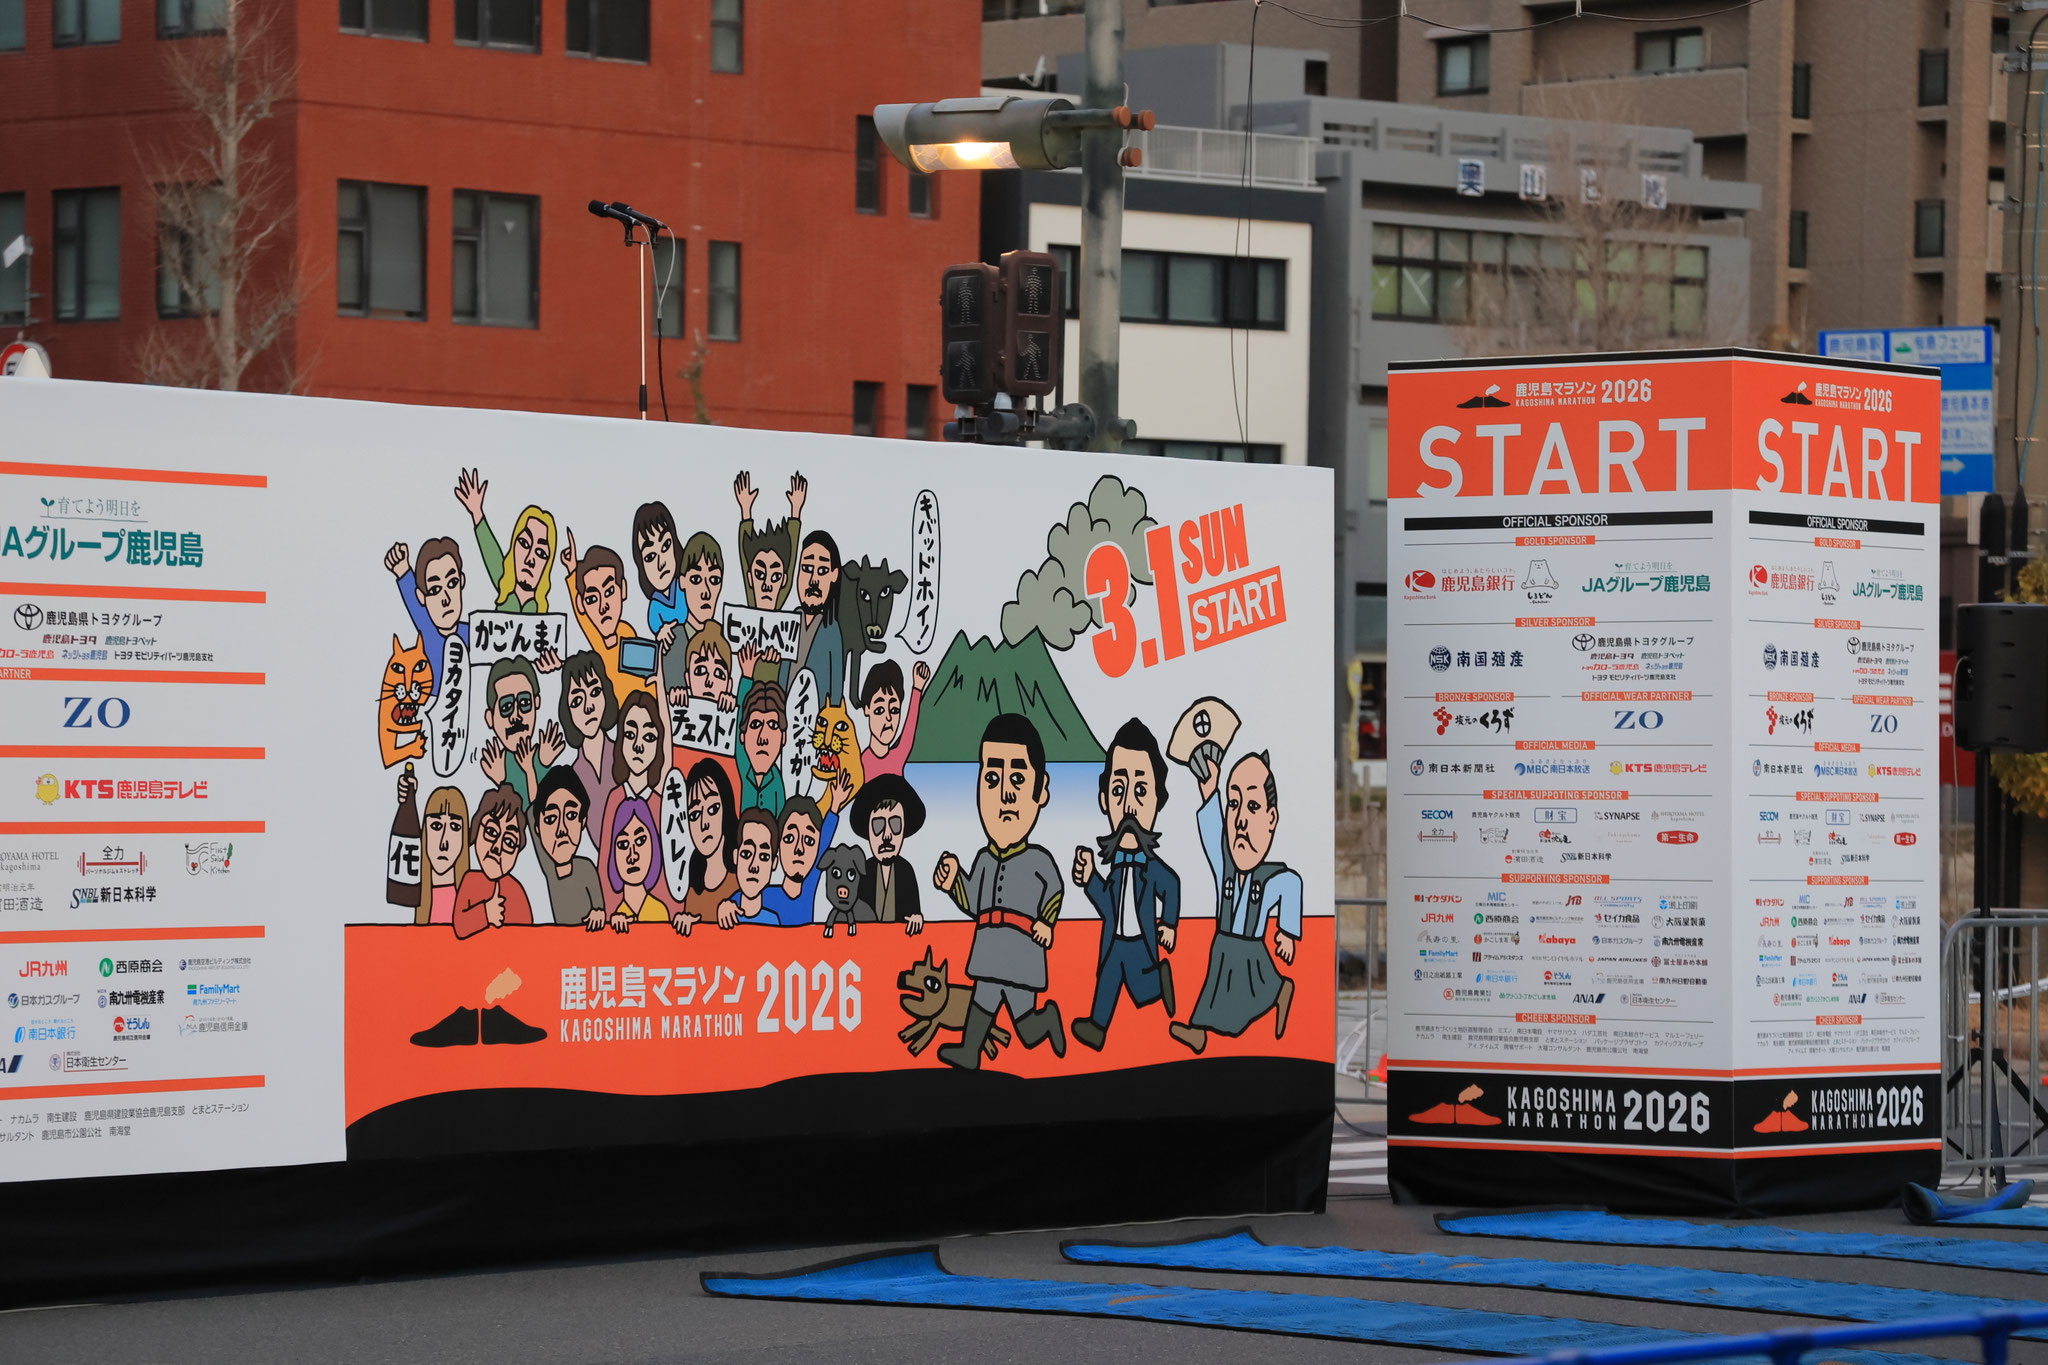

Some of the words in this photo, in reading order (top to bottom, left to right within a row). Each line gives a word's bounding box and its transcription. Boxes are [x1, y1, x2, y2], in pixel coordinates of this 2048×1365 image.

[1515, 381, 1597, 397] 鹿児島マラソン
[1601, 378, 1652, 403] 2026
[1515, 398, 1555, 407] KAGOSHIMA
[1557, 397, 1596, 406] MARATHON
[1815, 382, 1862, 400] 鹿児島マラソン
[1863, 387, 1893, 413] 2026
[1416, 417, 1706, 499] START
[1756, 418, 1921, 503] START
[57, 497, 141, 518] 育てよう明日を
[1502, 515, 1552, 528] OFFICIAL
[1554, 514, 1609, 527] SPONSOR
[1807, 515, 1836, 529] OFFICIAL
[1837, 517, 1868, 531] SPONSOR
[0, 525, 204, 568] Aグループ鹿児島
[1523, 537, 1546, 546] GOLD
[1548, 536, 1587, 545] SPONSOR
[1819, 538, 1834, 547] GOLD
[1835, 538, 1856, 549] SPONSOR
[1086, 525, 1186, 678] 3.1
[1179, 503, 1250, 584] SUN
[1441, 575, 1515, 593] 鹿児島銀行
[1582, 575, 1711, 593] JAグループ鹿児島
[1853, 582, 1923, 602] JAグループ鹿児島
[1192, 573, 1279, 641] START
[46, 610, 163, 627] 鹿児島県トヨタグループ
[1520, 618, 1549, 627] SILVER
[1551, 617, 1590, 626] SPONSOR
[1818, 619, 1834, 629] SILVER
[1835, 620, 1858, 630] SPONSOR
[1597, 636, 1694, 648] 鹿児島県トヨタグループ
[1457, 650, 1524, 668] 南国殖産
[1438, 693, 1470, 701] BRONZE
[1472, 692, 1511, 701] SPONSOR
[1584, 692, 1621, 701] OFFICIAL
[1623, 692, 1648, 700] WEAR
[1650, 691, 1690, 700] PARTNER
[1769, 691, 1788, 701] BRONZE
[1789, 692, 1812, 702] SPONSOR
[1853, 695, 1875, 705] OFFICIAL
[1890, 696, 1913, 706] PARTNER
[63, 697, 131, 728] ZO
[1614, 710, 1664, 730] ZO
[1870, 714, 1898, 733] ZO
[672, 709, 736, 750] チェスト!
[1522, 741, 1559, 750] OFFICIAL
[1561, 741, 1588, 749] MEDIA
[1818, 743, 1840, 752] OFFICIAL
[1841, 744, 1857, 752] MEDIA
[1428, 763, 1495, 774] 南日本新聞社
[1550, 764, 1590, 774] 南日本放送
[1625, 763, 1652, 773] KTS
[64, 780, 114, 799] KTS
[117, 780, 208, 799] 鹿児島テレビ
[1491, 790, 1528, 799] SPECIAL
[1530, 790, 1579, 800] SUPPOTING
[1582, 791, 1622, 800] SPONSOR
[1800, 792, 1821, 801] SPECIAL
[1852, 793, 1875, 802] SPONSOR
[1421, 809, 1453, 819] SECOM
[1604, 811, 1640, 821] SYNAPSE
[32, 851, 59, 860] HOTEL
[102, 846, 125, 861] 全力
[1509, 874, 1561, 883] SUPPORTING
[1563, 875, 1602, 883] SPONSOR
[1811, 876, 1841, 885] SUPPORTING
[1842, 876, 1865, 885] SPONSOR
[100, 886, 156, 903] 新日本科学
[1565, 895, 1582, 906] JTB
[1421, 913, 1454, 923] JR九州
[1604, 914, 1640, 923] セイカ食品
[1538, 933, 1576, 945] Kabaya
[19, 960, 68, 977] JR九州
[116, 959, 163, 973] 西原商会
[199, 984, 240, 995] FamilyMart
[21, 993, 80, 1006] 日本ガスグループ
[560, 964, 746, 1011] 鹿児島マラソン
[756, 959, 862, 1034] 2026
[1572, 993, 1595, 1004] ANA
[126, 1018, 150, 1030] そうしん
[1521, 1013, 1546, 1023] CHEER
[1549, 1014, 1590, 1024] SPONSOR
[28, 1026, 76, 1040] 南日本銀行
[199, 1021, 248, 1033] 鹿児島信用金庫
[560, 1014, 653, 1043] KAGOSHIMA
[661, 1012, 743, 1039] MARATHON
[66, 1056, 127, 1068] 日本衛生センター
[1507, 1086, 1616, 1113] KAGOSHIMA
[1623, 1089, 1710, 1134] 2026
[1811, 1088, 1873, 1113] KAGOSHIMA
[1877, 1085, 1923, 1128] 2026
[10, 1114, 39, 1124] ナカムラ
[192, 1103, 249, 1114] とまとステーション
[1507, 1111, 1617, 1131] MARATHON
[1811, 1113, 1874, 1131] MARATHON
[41, 1127, 102, 1140] 鹿児島市公園公社
